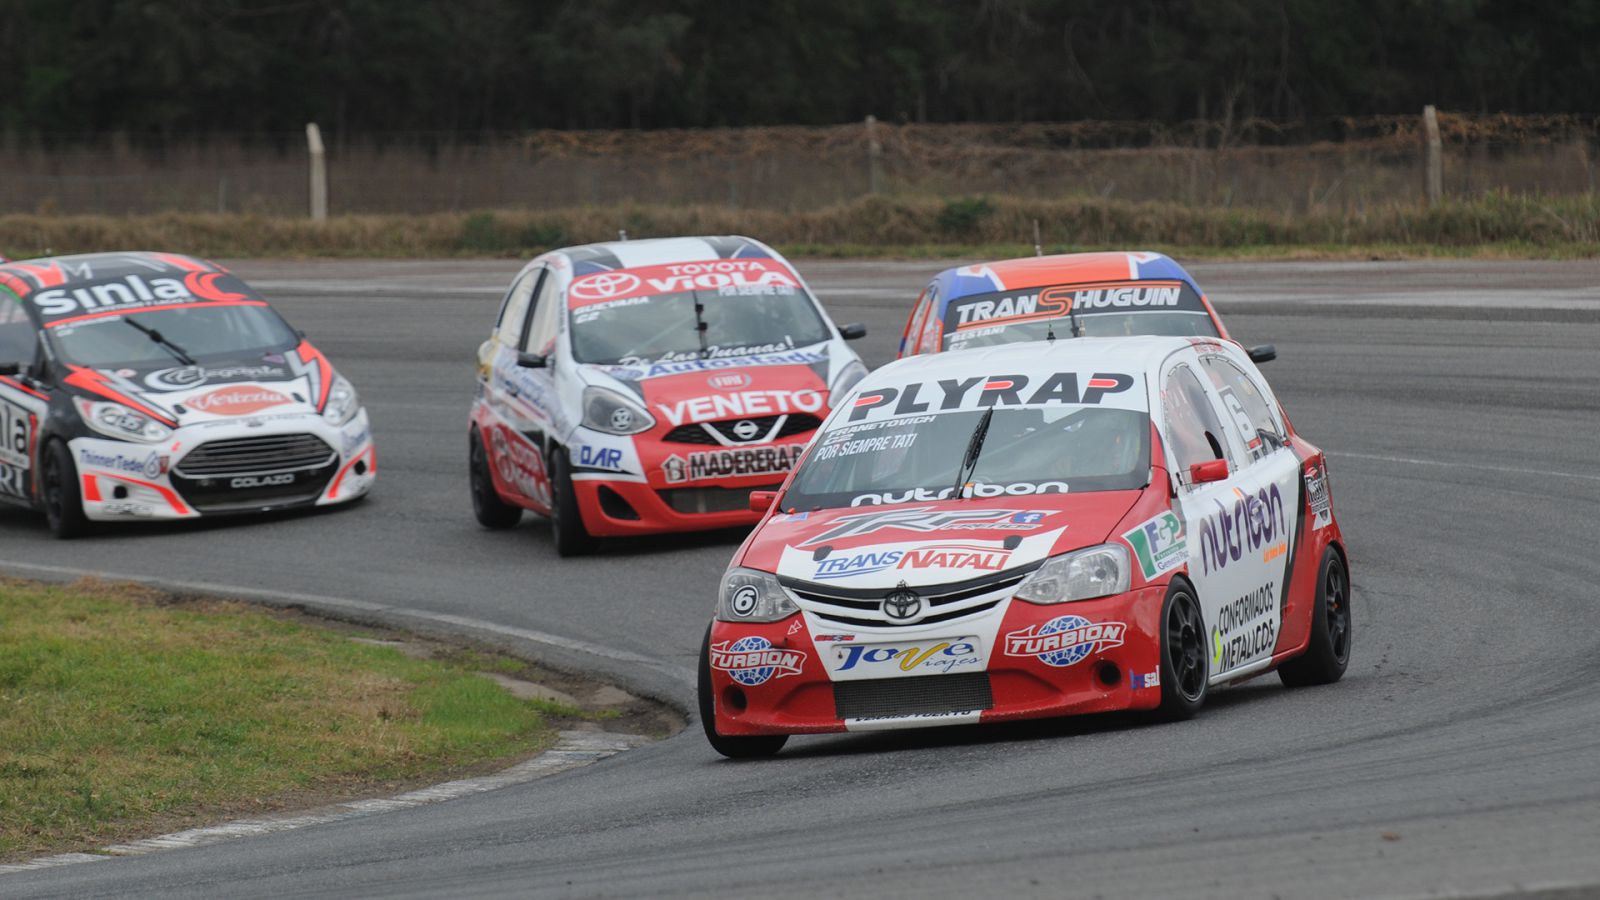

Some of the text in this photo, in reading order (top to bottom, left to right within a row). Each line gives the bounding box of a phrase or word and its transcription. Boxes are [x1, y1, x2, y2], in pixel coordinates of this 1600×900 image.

[667, 260, 767, 276] TOYOTA
[657, 389, 823, 426] VENETO
[848, 372, 1134, 423] PLYRAP
[813, 442, 841, 462] POR
[838, 435, 892, 457] SIEMPRE
[890, 433, 918, 449] TATI
[691, 448, 793, 479] MADERERA
[231, 473, 295, 488] COLAZO
[850, 481, 1069, 507] nutribon
[741, 589, 754, 613] 6
[1218, 582, 1273, 634] CONFORMADOS
[1010, 625, 1121, 653] TURBION
[1220, 618, 1274, 672] METALICOS
[710, 650, 800, 668] TURBION
